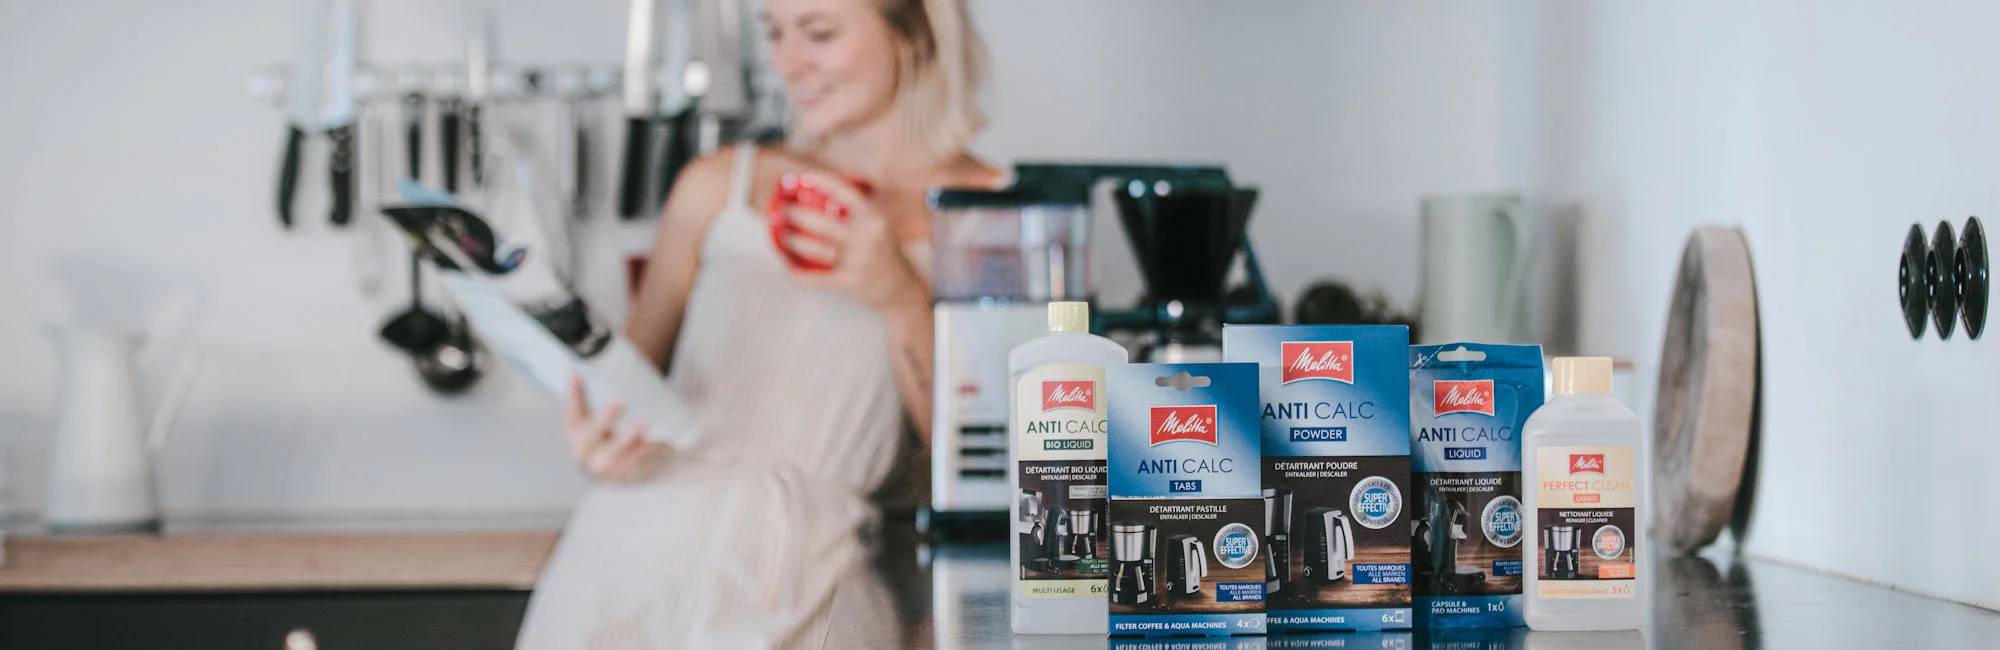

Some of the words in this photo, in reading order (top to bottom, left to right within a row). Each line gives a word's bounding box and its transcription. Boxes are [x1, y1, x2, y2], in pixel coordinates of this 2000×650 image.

[1261, 403, 1308, 419] ANTI
[1314, 401, 1374, 419] CALC
[1026, 421, 1060, 434] ANTI
[1293, 429, 1343, 439] POWDER
[1418, 428, 1456, 442] ANTI
[1461, 427, 1512, 442] CALC
[1046, 441, 1061, 449] BIO
[1449, 449, 1481, 458] LIQUID
[1025, 465, 1070, 474] DÉTARTRANT
[1137, 459, 1177, 474] ANTI
[1182, 458, 1233, 474] CALC
[1275, 461, 1324, 470] DÉTARTRANT
[1326, 462, 1358, 470] POUDRE
[1475, 477, 1502, 485] LIQUIDE
[1543, 481, 1589, 491] PERFECT
[1592, 480, 1630, 491] CLEAN
[1174, 482, 1196, 491] TABS
[1364, 493, 1387, 503] SUPER
[1150, 505, 1195, 513] DÉTARTRANT
[1196, 505, 1227, 513] PASTILLE
[1358, 503, 1394, 512] EFFECTIVE
[1495, 512, 1516, 522] SUPER
[1226, 537, 1246, 546] SUPER
[1220, 546, 1252, 554] EFFECTIVE
